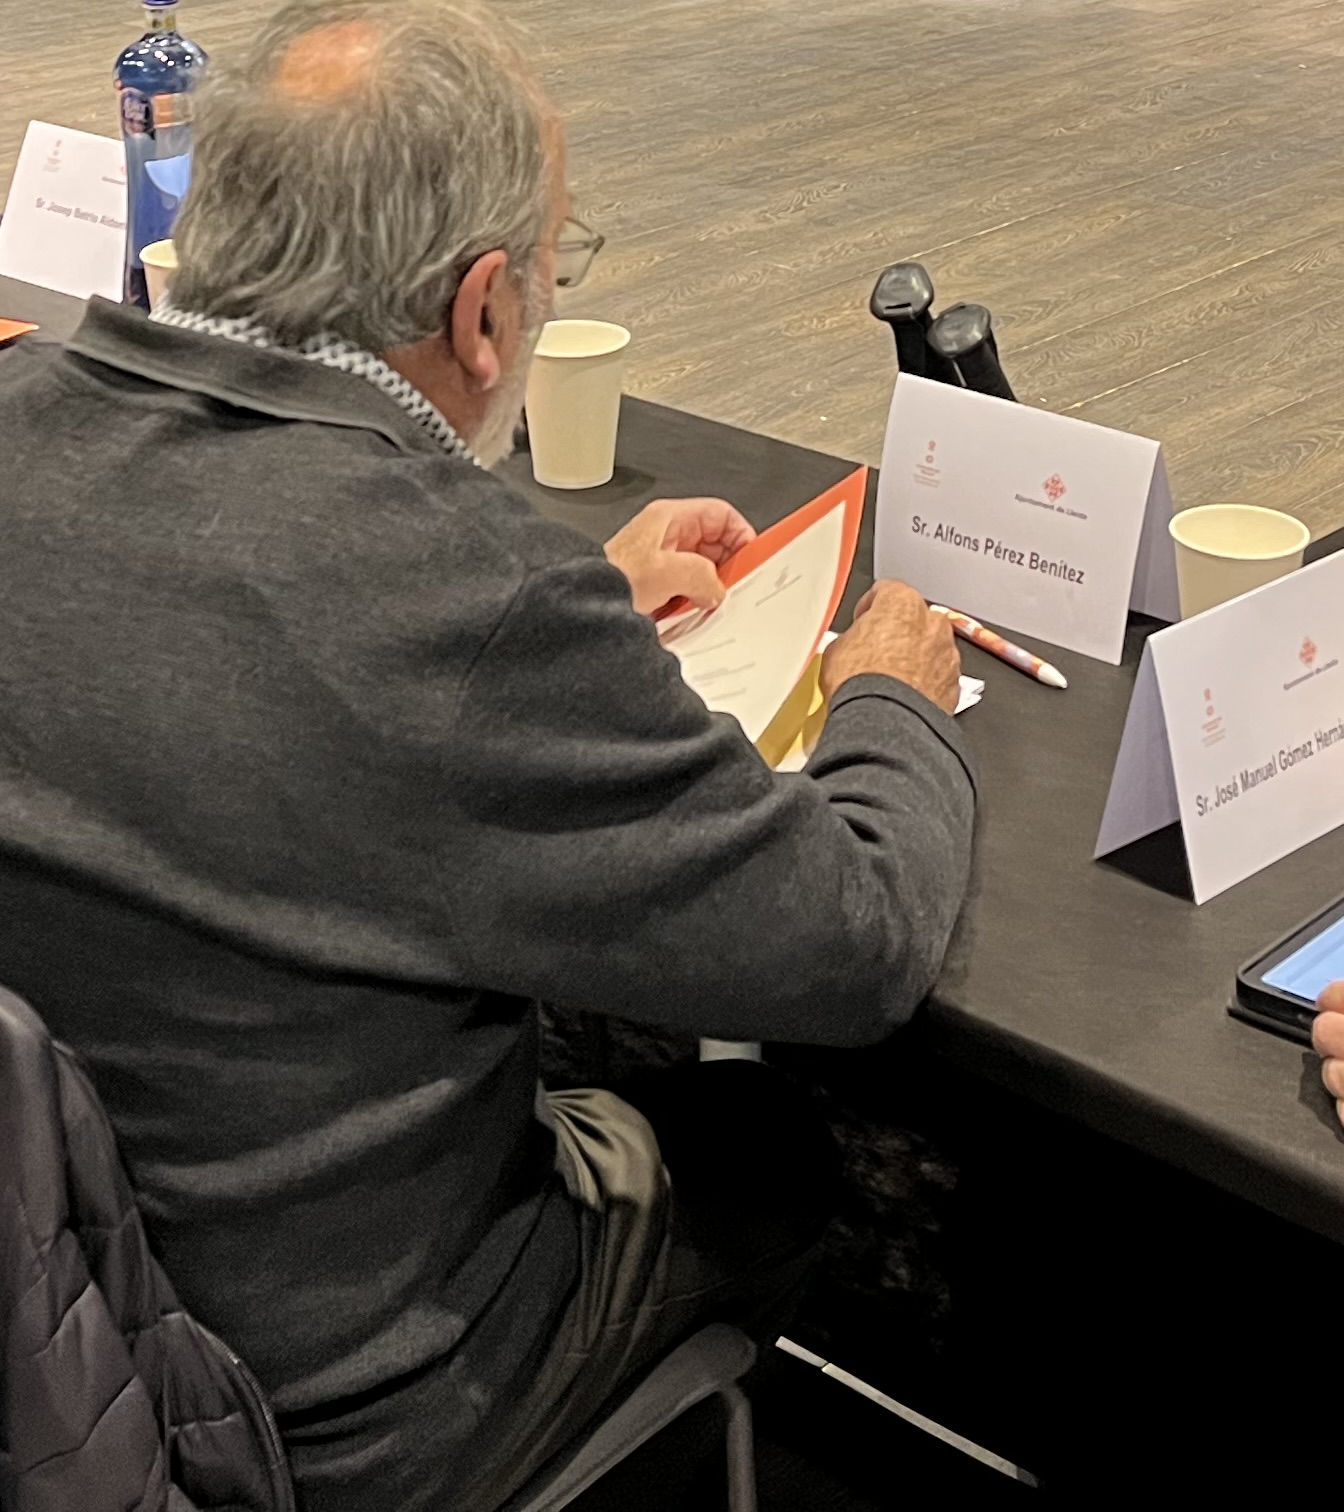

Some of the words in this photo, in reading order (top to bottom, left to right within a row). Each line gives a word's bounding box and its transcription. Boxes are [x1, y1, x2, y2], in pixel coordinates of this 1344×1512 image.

[910, 515, 931, 538] Sr.
[933, 523, 979, 553] Alfons
[984, 537, 1025, 567] Pérez
[1028, 552, 1085, 585] Benítez
[1195, 793, 1213, 818] Sr.
[1214, 775, 1239, 808] José
[1241, 754, 1278, 793] Manuel
[1278, 737, 1315, 772] Gómez
